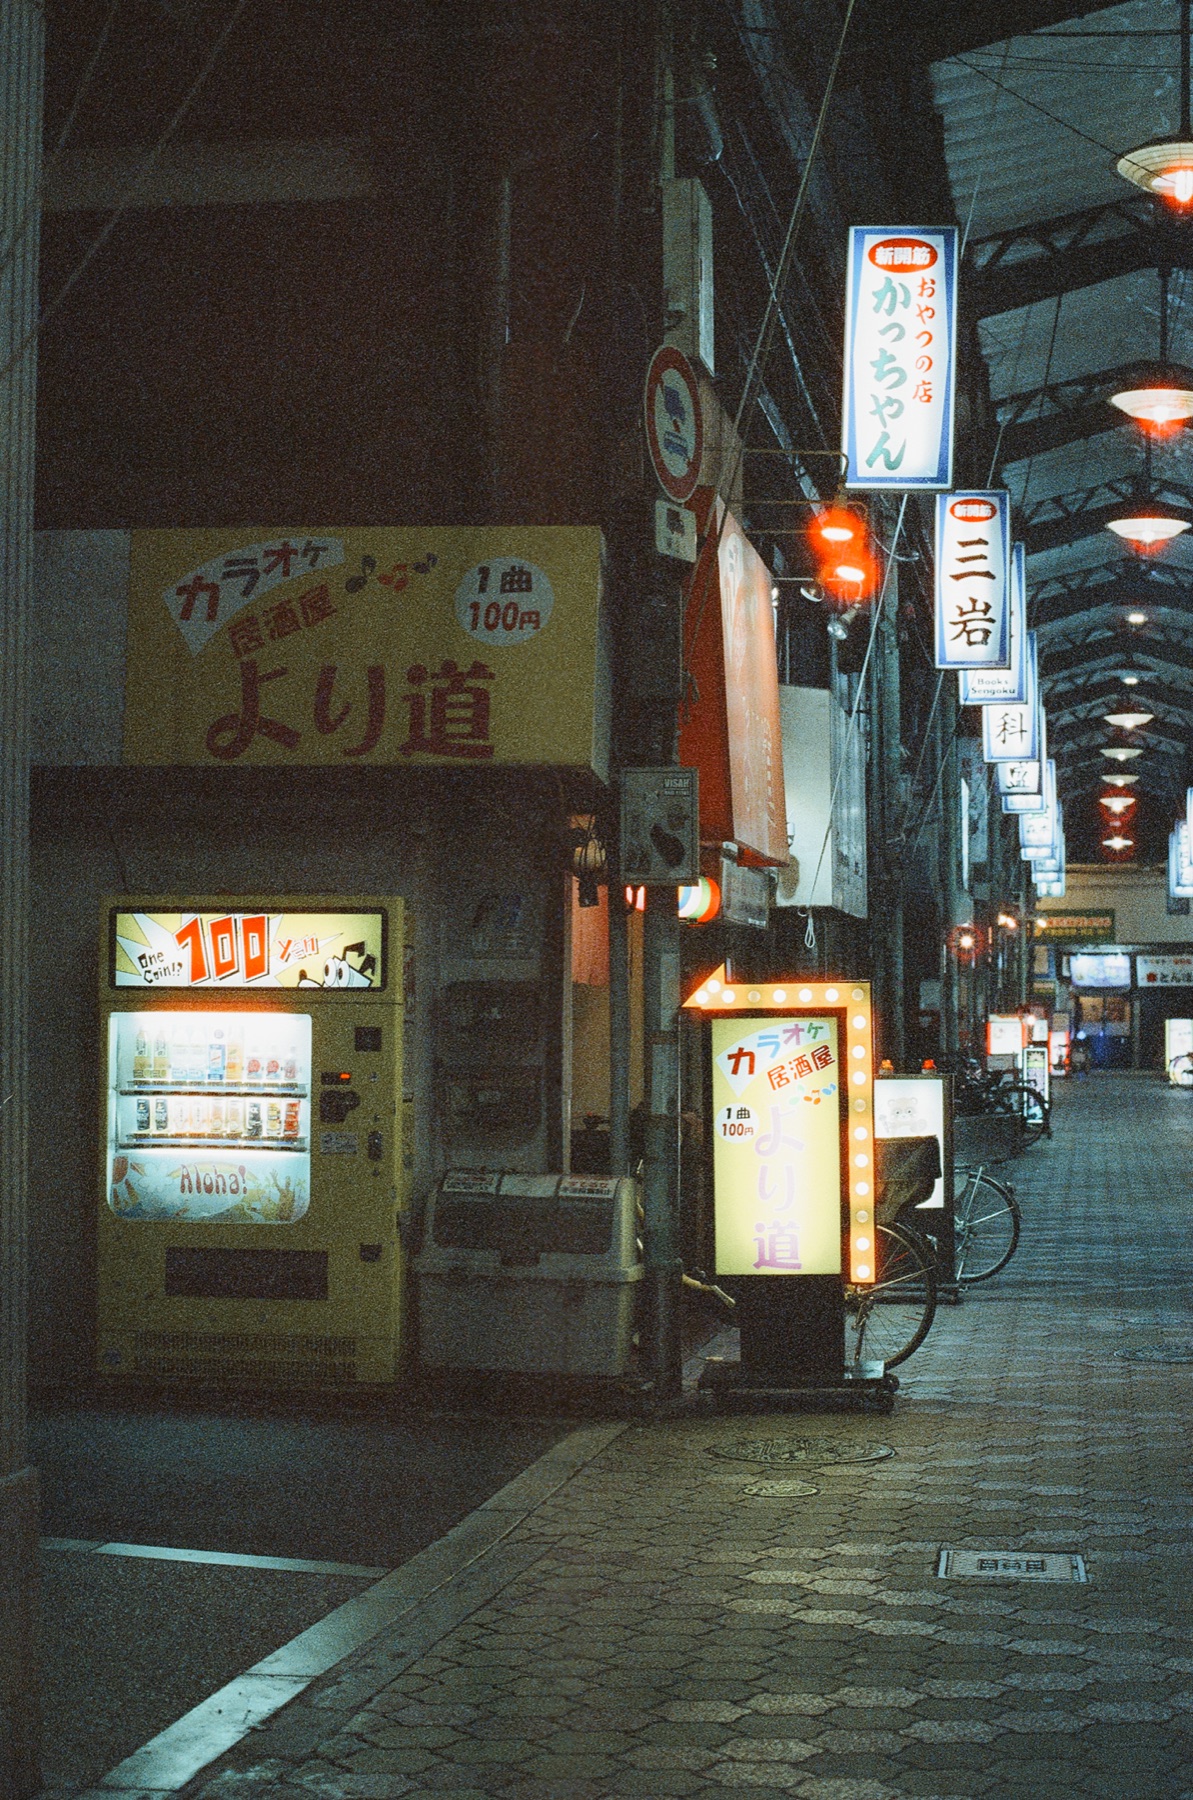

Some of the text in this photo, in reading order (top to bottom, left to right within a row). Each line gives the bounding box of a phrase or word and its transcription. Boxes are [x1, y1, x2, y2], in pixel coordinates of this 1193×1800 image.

[875, 246, 931, 266] 新開筋
[912, 277, 936, 404] おやつの店
[865, 276, 911, 471] かっちゃん
[175, 540, 330, 623] カラオケ
[476, 565, 533, 595] 1曲
[949, 537, 996, 647] 三岩
[228, 583, 338, 658] 居酒屋
[468, 601, 541, 633] 100円
[971, 687, 1016, 695] Sengoku
[977, 678, 1009, 686] Books
[206, 659, 497, 760] より道
[138, 951, 165, 970] One
[173, 914, 270, 985] 100
[727, 1022, 825, 1076] カラオケ
[766, 1044, 836, 1091] 居酒屋
[721, 1122, 754, 1137] 100円
[725, 1107, 750, 1120] 1曲
[179, 1163, 249, 1196] Aloha!
[752, 1105, 806, 1270] より道
